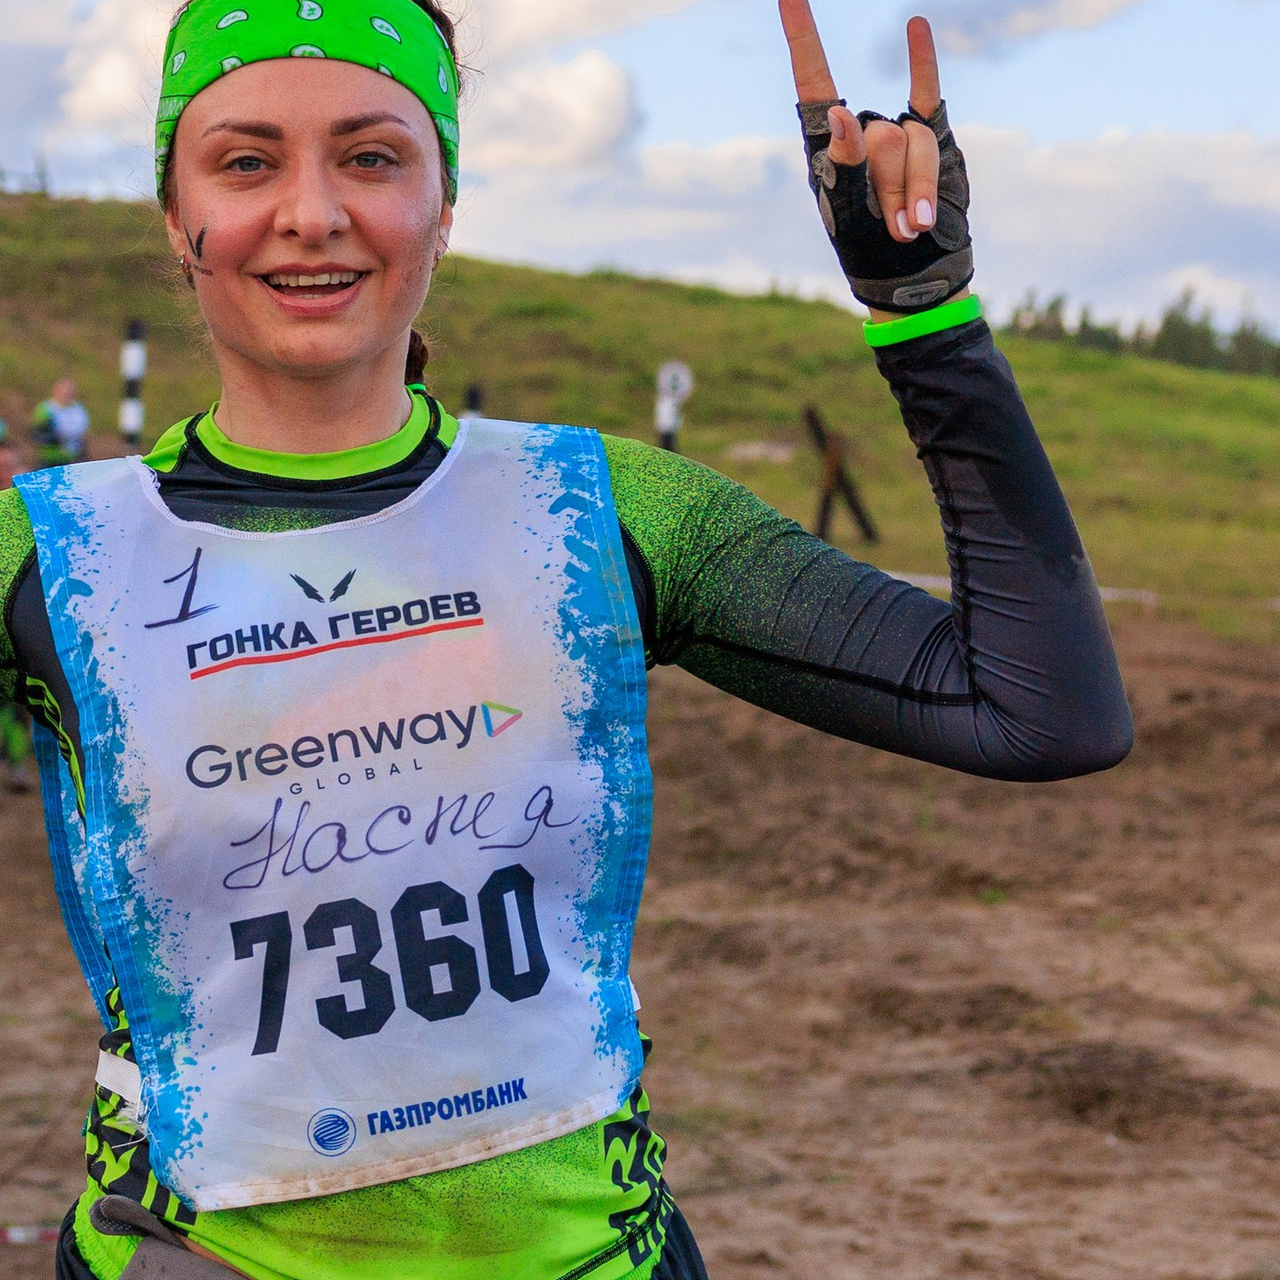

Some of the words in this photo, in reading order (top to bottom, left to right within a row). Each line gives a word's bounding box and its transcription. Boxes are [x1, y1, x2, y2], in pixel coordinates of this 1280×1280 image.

[144, 546, 221, 629] 1
[186, 621, 318, 669] ГОНКА
[328, 591, 481, 640] ГЕРОЕВ
[185, 705, 477, 789] Greenway
[289, 758, 423, 795] GLOBAL
[229, 863, 550, 1056] 7360
[367, 1078, 528, 1136] ГАЗПРОМБАНК
